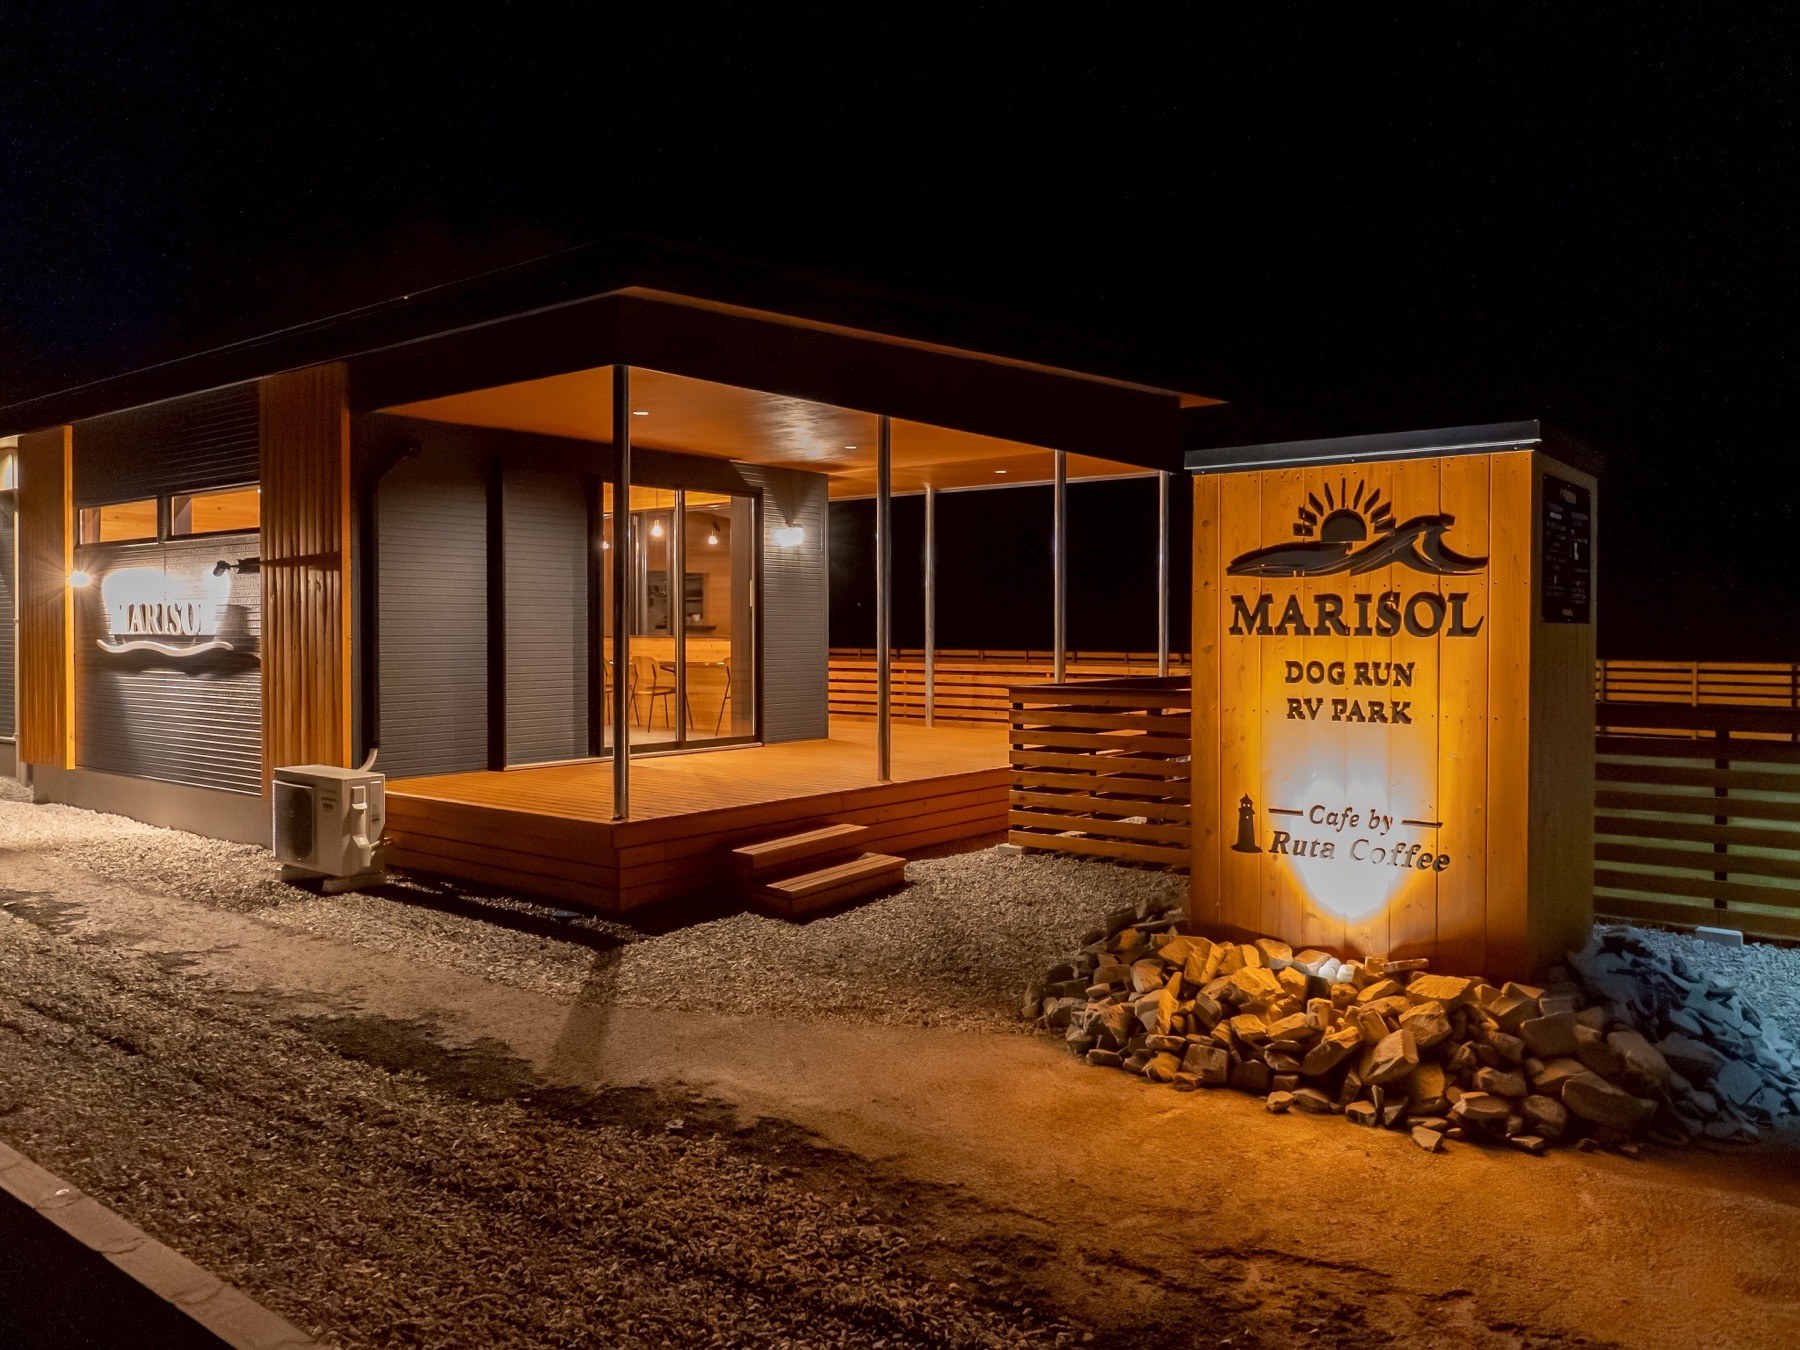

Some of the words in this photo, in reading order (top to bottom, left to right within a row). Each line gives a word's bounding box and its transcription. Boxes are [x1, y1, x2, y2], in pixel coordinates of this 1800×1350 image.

[109, 602, 216, 636] ARISO
[1228, 591, 1485, 638] MARISOL
[1285, 660, 1347, 686] DOG
[1353, 661, 1416, 688] RUN
[1286, 697, 1324, 721] RV
[1332, 699, 1413, 725] PARK
[1308, 804, 1360, 831] Cafe
[1367, 808, 1395, 836] by
[1268, 831, 1336, 861] Ruta
[1349, 837, 1451, 873] Coffee
